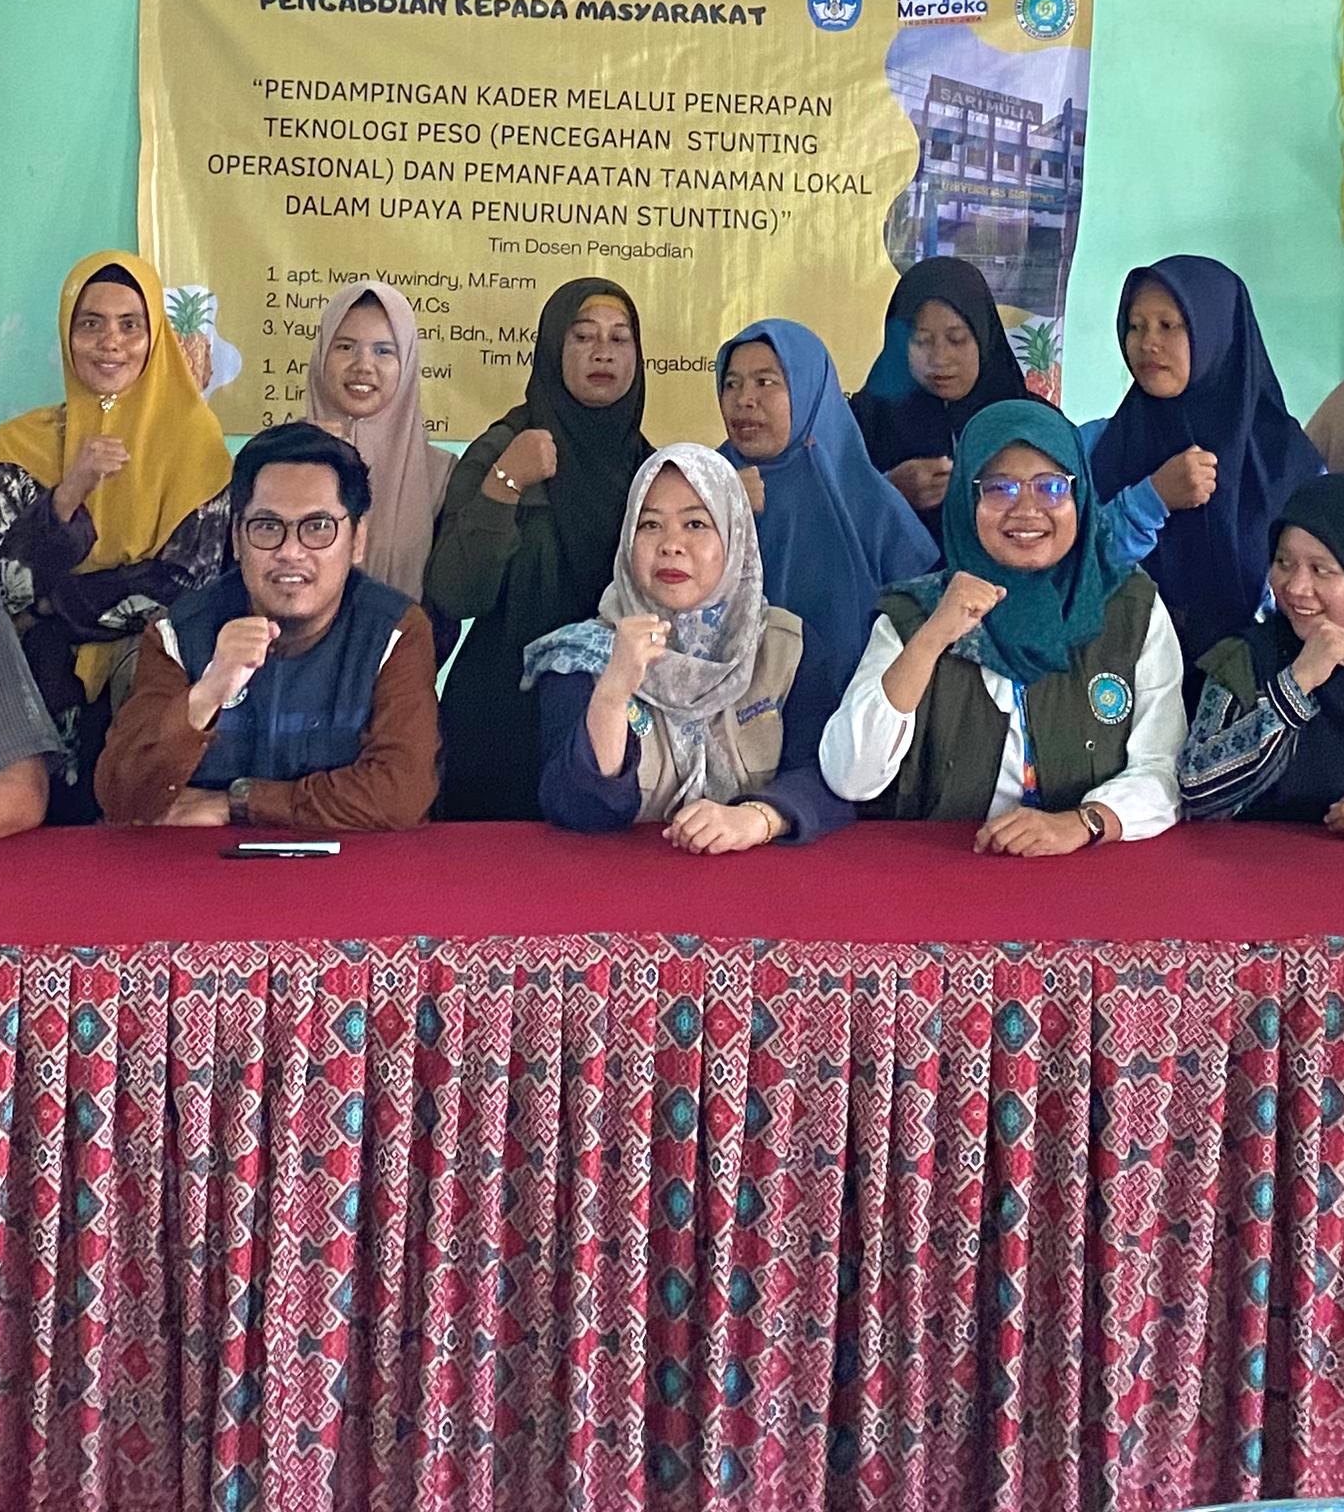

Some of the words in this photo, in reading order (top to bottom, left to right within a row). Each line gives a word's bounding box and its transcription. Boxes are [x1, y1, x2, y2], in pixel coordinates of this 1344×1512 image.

[576, 0, 766, 26] MASYARAKAT
[477, 86, 557, 108] KADER
[568, 89, 675, 111] MELALUI
[685, 93, 831, 116] PENERAPAN
[264, 117, 408, 141] TEKNOLOGI
[418, 123, 480, 144] PESO
[491, 123, 670, 150] (PENCEGAHAN
[688, 131, 817, 155] STUNTING
[208, 154, 393, 185] OPERASIONAL)
[405, 160, 454, 181] DAN
[465, 162, 650, 187] PEMANFAATAN
[660, 169, 783, 192] TANAMAN
[794, 173, 872, 194] LOKAL
[286, 195, 369, 217] DALAM
[381, 198, 462, 220] UPAYA
[472, 201, 627, 225] PENURUNAN
[489, 237, 520, 252] Tim
[526, 239, 581, 255] Dosen
[588, 241, 693, 260] Pengabdian
[287, 269, 323, 286] apt.
[376, 270, 462, 290] Yuwindry,
[469, 273, 536, 289] M.Farm
[450, 325, 493, 344] Bdn.,
[480, 350, 510, 365] Tim
